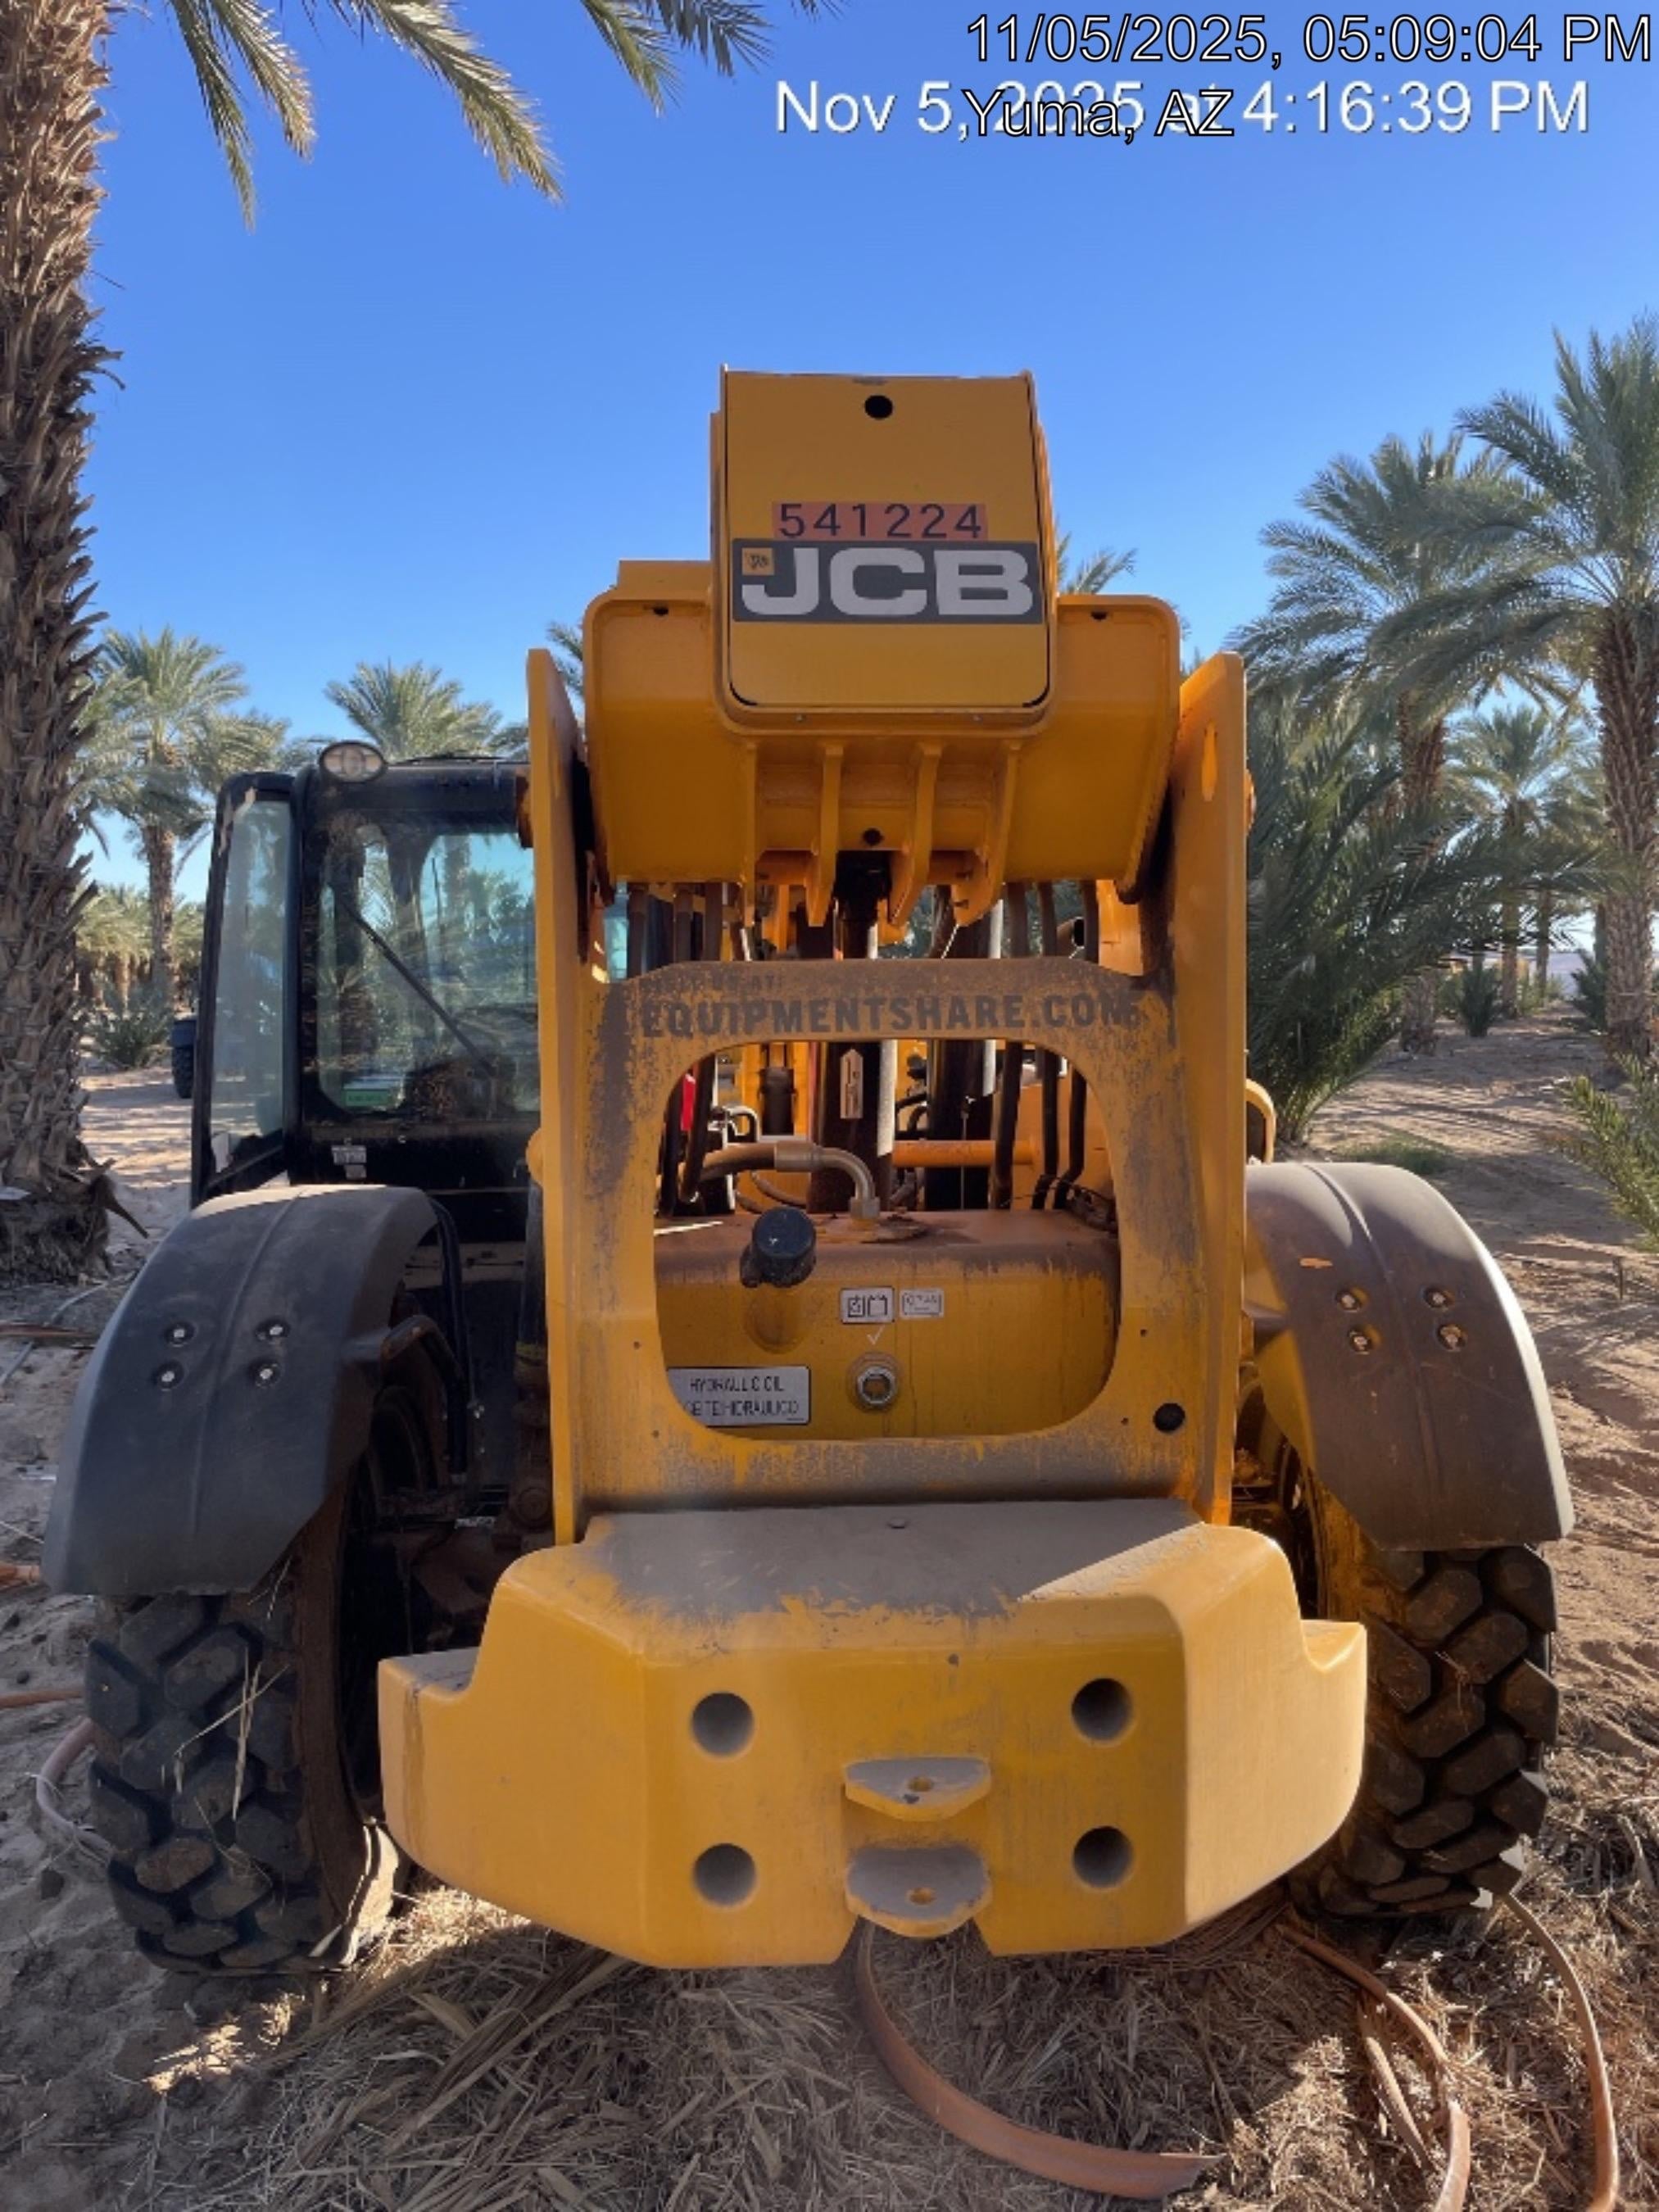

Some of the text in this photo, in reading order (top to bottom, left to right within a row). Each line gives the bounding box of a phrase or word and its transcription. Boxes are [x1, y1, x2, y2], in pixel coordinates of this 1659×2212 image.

[779, 503, 981, 539] 541224
[741, 546, 1034, 616] JCB
[641, 991, 1135, 1038] EQUIPMENTSHARE.COM
